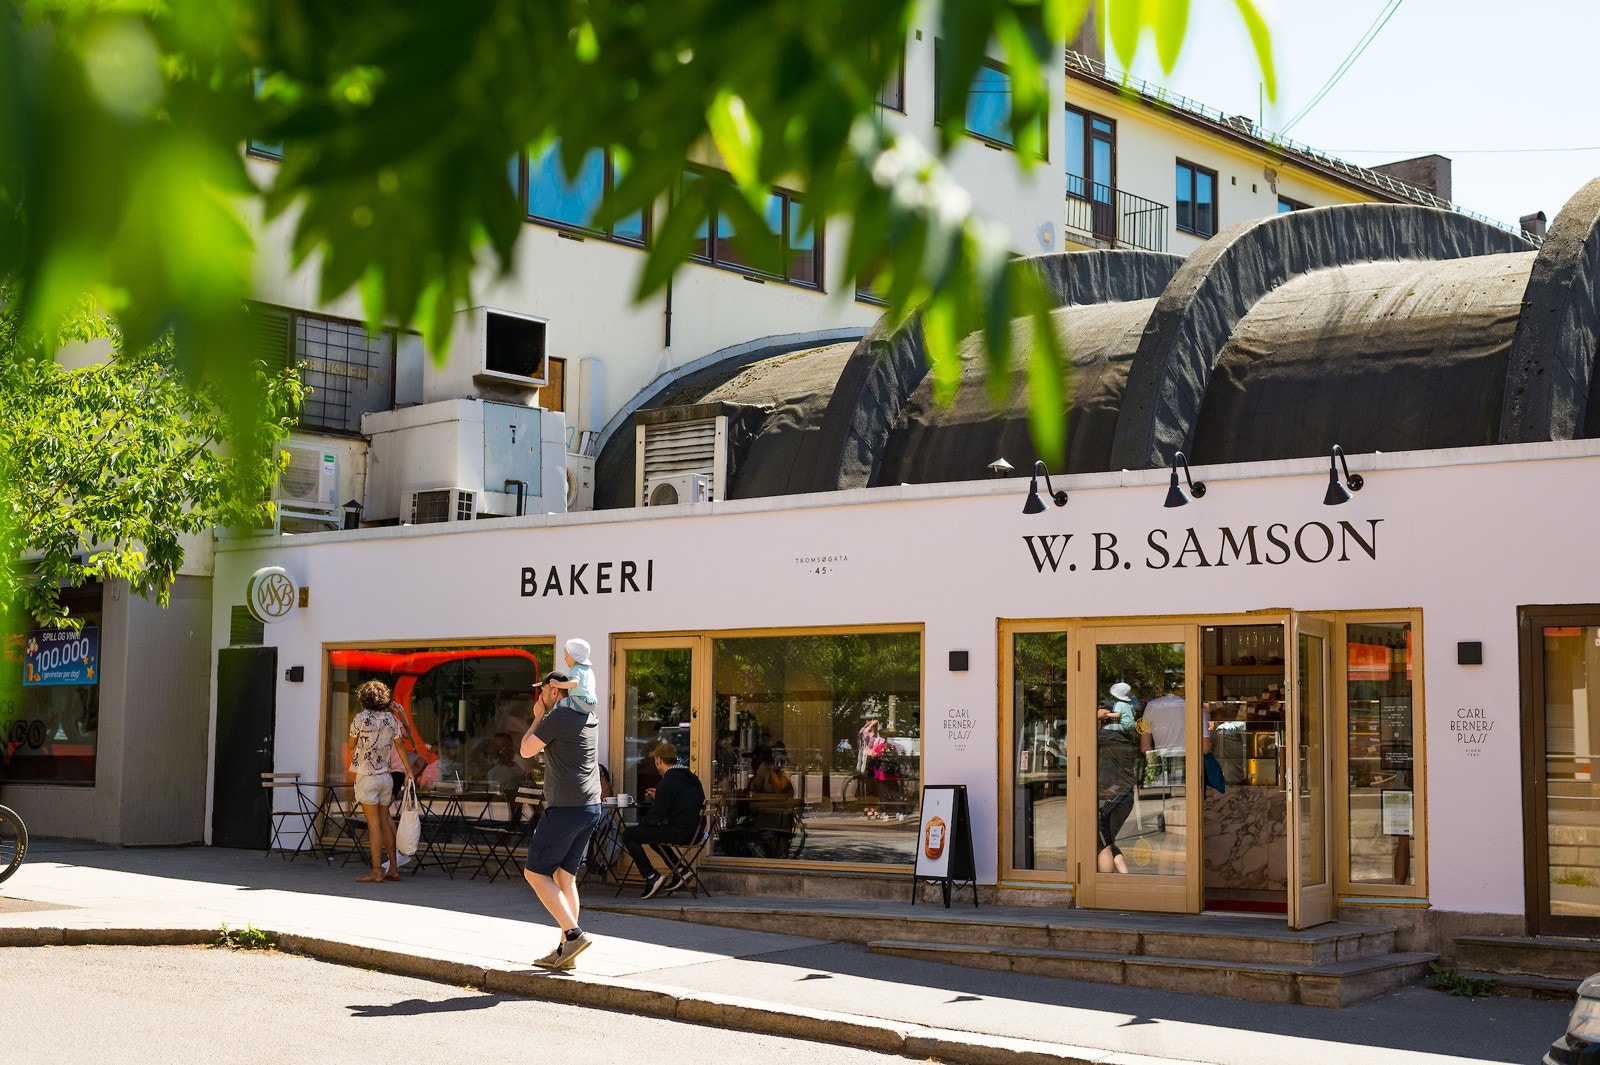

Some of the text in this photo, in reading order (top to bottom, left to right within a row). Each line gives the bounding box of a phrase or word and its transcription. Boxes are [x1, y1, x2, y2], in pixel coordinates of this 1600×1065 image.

[1022, 518, 1385, 574] W. B. SAMSON
[520, 559, 654, 597] BAKERI
[42, 632, 57, 642] SPILL
[58, 632, 66, 641] OG
[36, 637, 89, 673] 100.000
[948, 708, 970, 719] CARL
[1457, 708, 1487, 719] CARL
[943, 719, 977, 729] BERNERS
[1450, 720, 1495, 731] BERNERS
[948, 730, 972, 740] PLASS
[1457, 733, 1488, 744] PLASS
